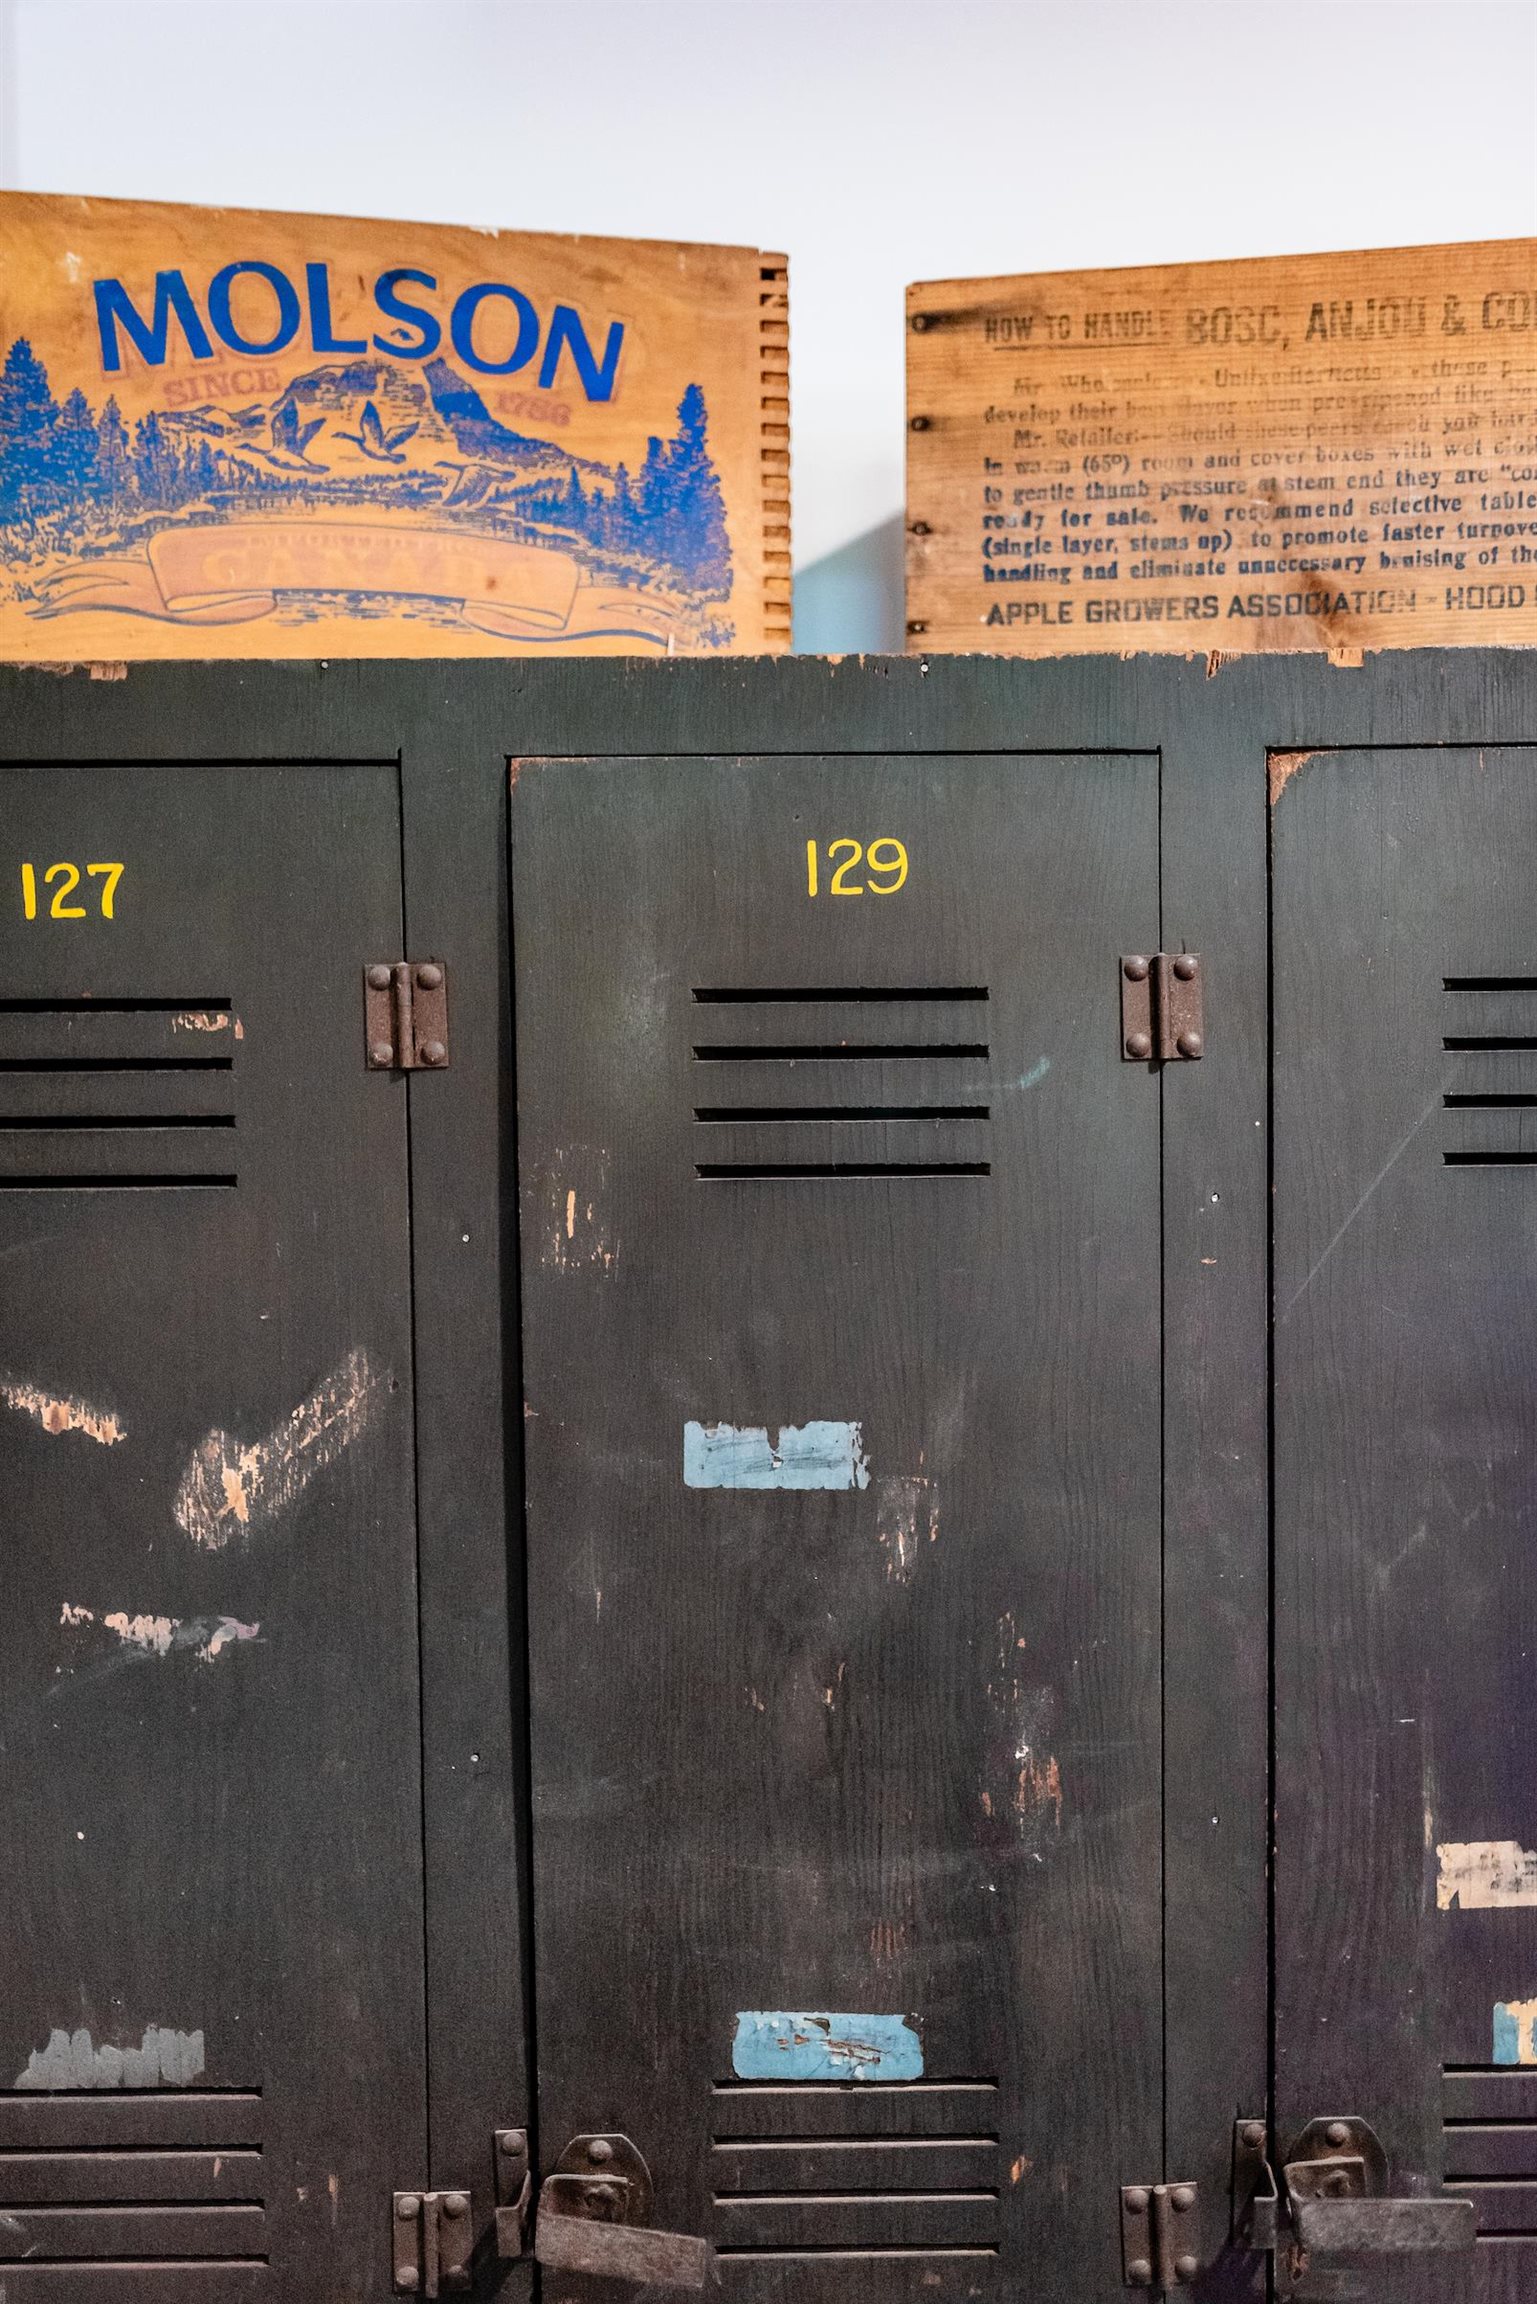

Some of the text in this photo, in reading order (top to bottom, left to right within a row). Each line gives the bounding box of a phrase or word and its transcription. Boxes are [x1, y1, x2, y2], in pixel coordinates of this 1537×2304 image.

[93, 260, 625, 402] MOLSON
[984, 315, 1033, 343] HOW
[1044, 314, 1071, 341] TO
[1084, 309, 1172, 341] HANDLE
[1185, 305, 1290, 351] BOSC,
[1304, 297, 1427, 342] ANJOU
[1440, 293, 1467, 337] &
[163, 367, 281, 407] SINCE
[983, 405, 1062, 425] develop
[1069, 400, 1119, 421] their
[1141, 455, 1194, 473] room
[1204, 448, 1242, 470] and
[1250, 451, 1305, 467] cover
[1316, 444, 1376, 464] boxes
[1388, 437, 1432, 460] with
[1444, 438, 1482, 457] wet
[983, 485, 1004, 504] to
[1013, 482, 1075, 506] gentle
[1086, 480, 1149, 501] thumb
[1160, 480, 1248, 502] pressure
[1258, 477, 1279, 493] at
[1284, 476, 1336, 491] stem
[1346, 469, 1385, 489] end
[1396, 468, 1442, 490] they
[1454, 469, 1490, 485] are
[982, 510, 1046, 532] ready
[1060, 508, 1093, 528] for
[1105, 507, 1158, 527] sale.
[1178, 504, 1209, 524] We
[1223, 498, 1354, 523] recommend
[1369, 494, 1463, 516] selective
[981, 535, 1053, 560] (single
[1062, 535, 1119, 555] layer,
[1129, 530, 1190, 553] stems
[1197, 529, 1233, 554] up)
[1251, 530, 1273, 548] to
[1281, 525, 1369, 552] promote
[1382, 522, 1446, 543] faster
[984, 563, 1072, 585] handling
[1082, 560, 1119, 581] and
[1129, 559, 1227, 580] eliminate
[1238, 555, 1367, 575] unnecessary
[1379, 548, 1467, 572] bruising
[1477, 545, 1500, 567] of
[985, 600, 1074, 627] APPLE
[1085, 594, 1220, 624] GROWERS
[1225, 588, 1418, 620] ASSOCIATION
[1444, 585, 1526, 612] HOOD
[806, 838, 909, 897] 129
[22, 862, 125, 920] 127
